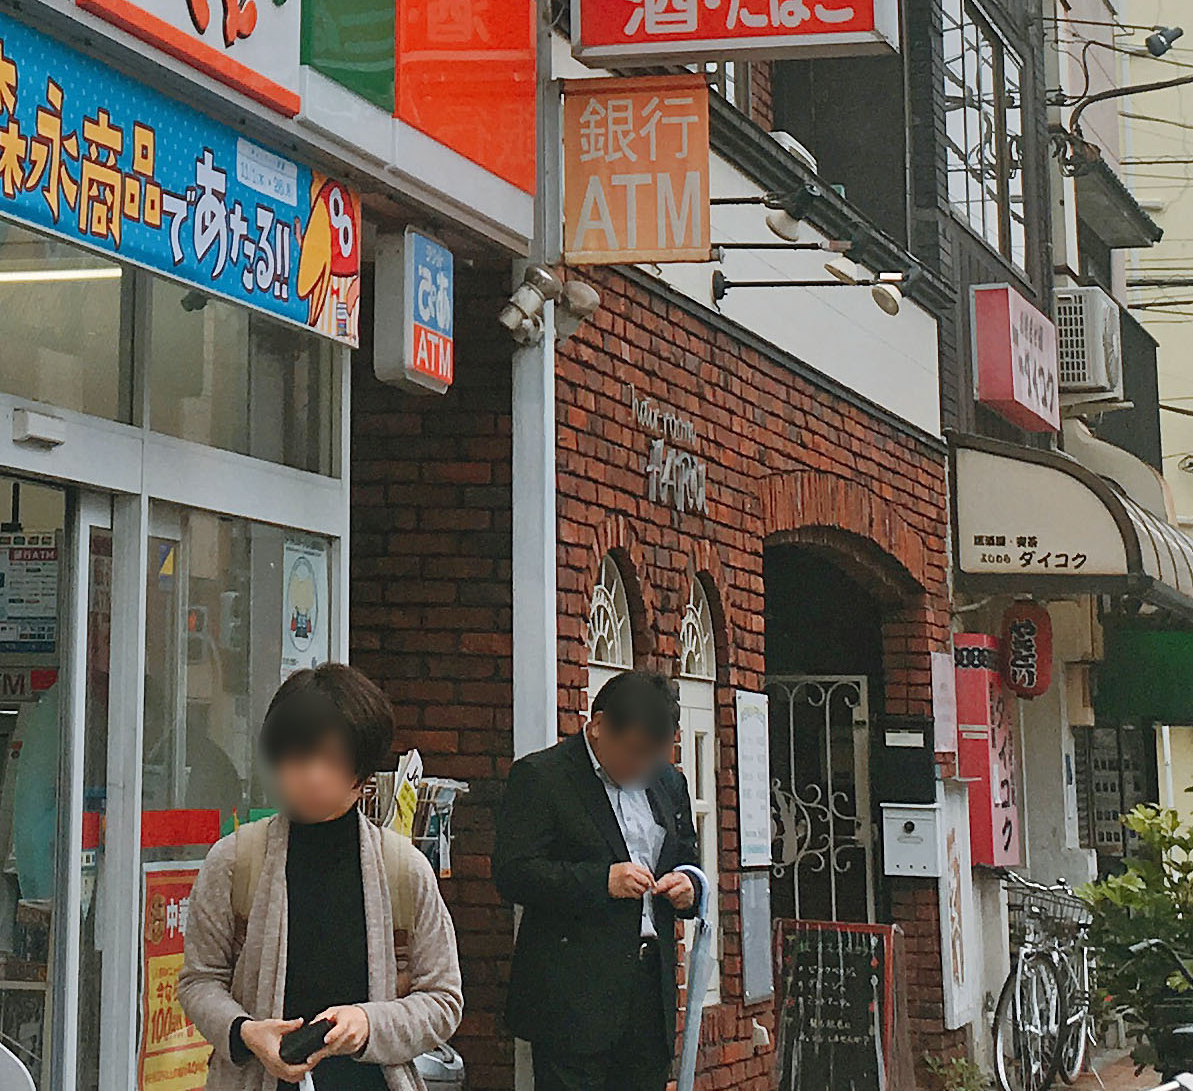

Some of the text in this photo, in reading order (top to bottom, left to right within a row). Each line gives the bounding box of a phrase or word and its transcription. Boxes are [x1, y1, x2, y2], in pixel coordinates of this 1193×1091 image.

[579, 96, 698, 164] 銀行
[573, 172, 702, 253] ATM
[416, 330, 451, 378] ATM
[1019, 550, 1087, 569] ダイコク
